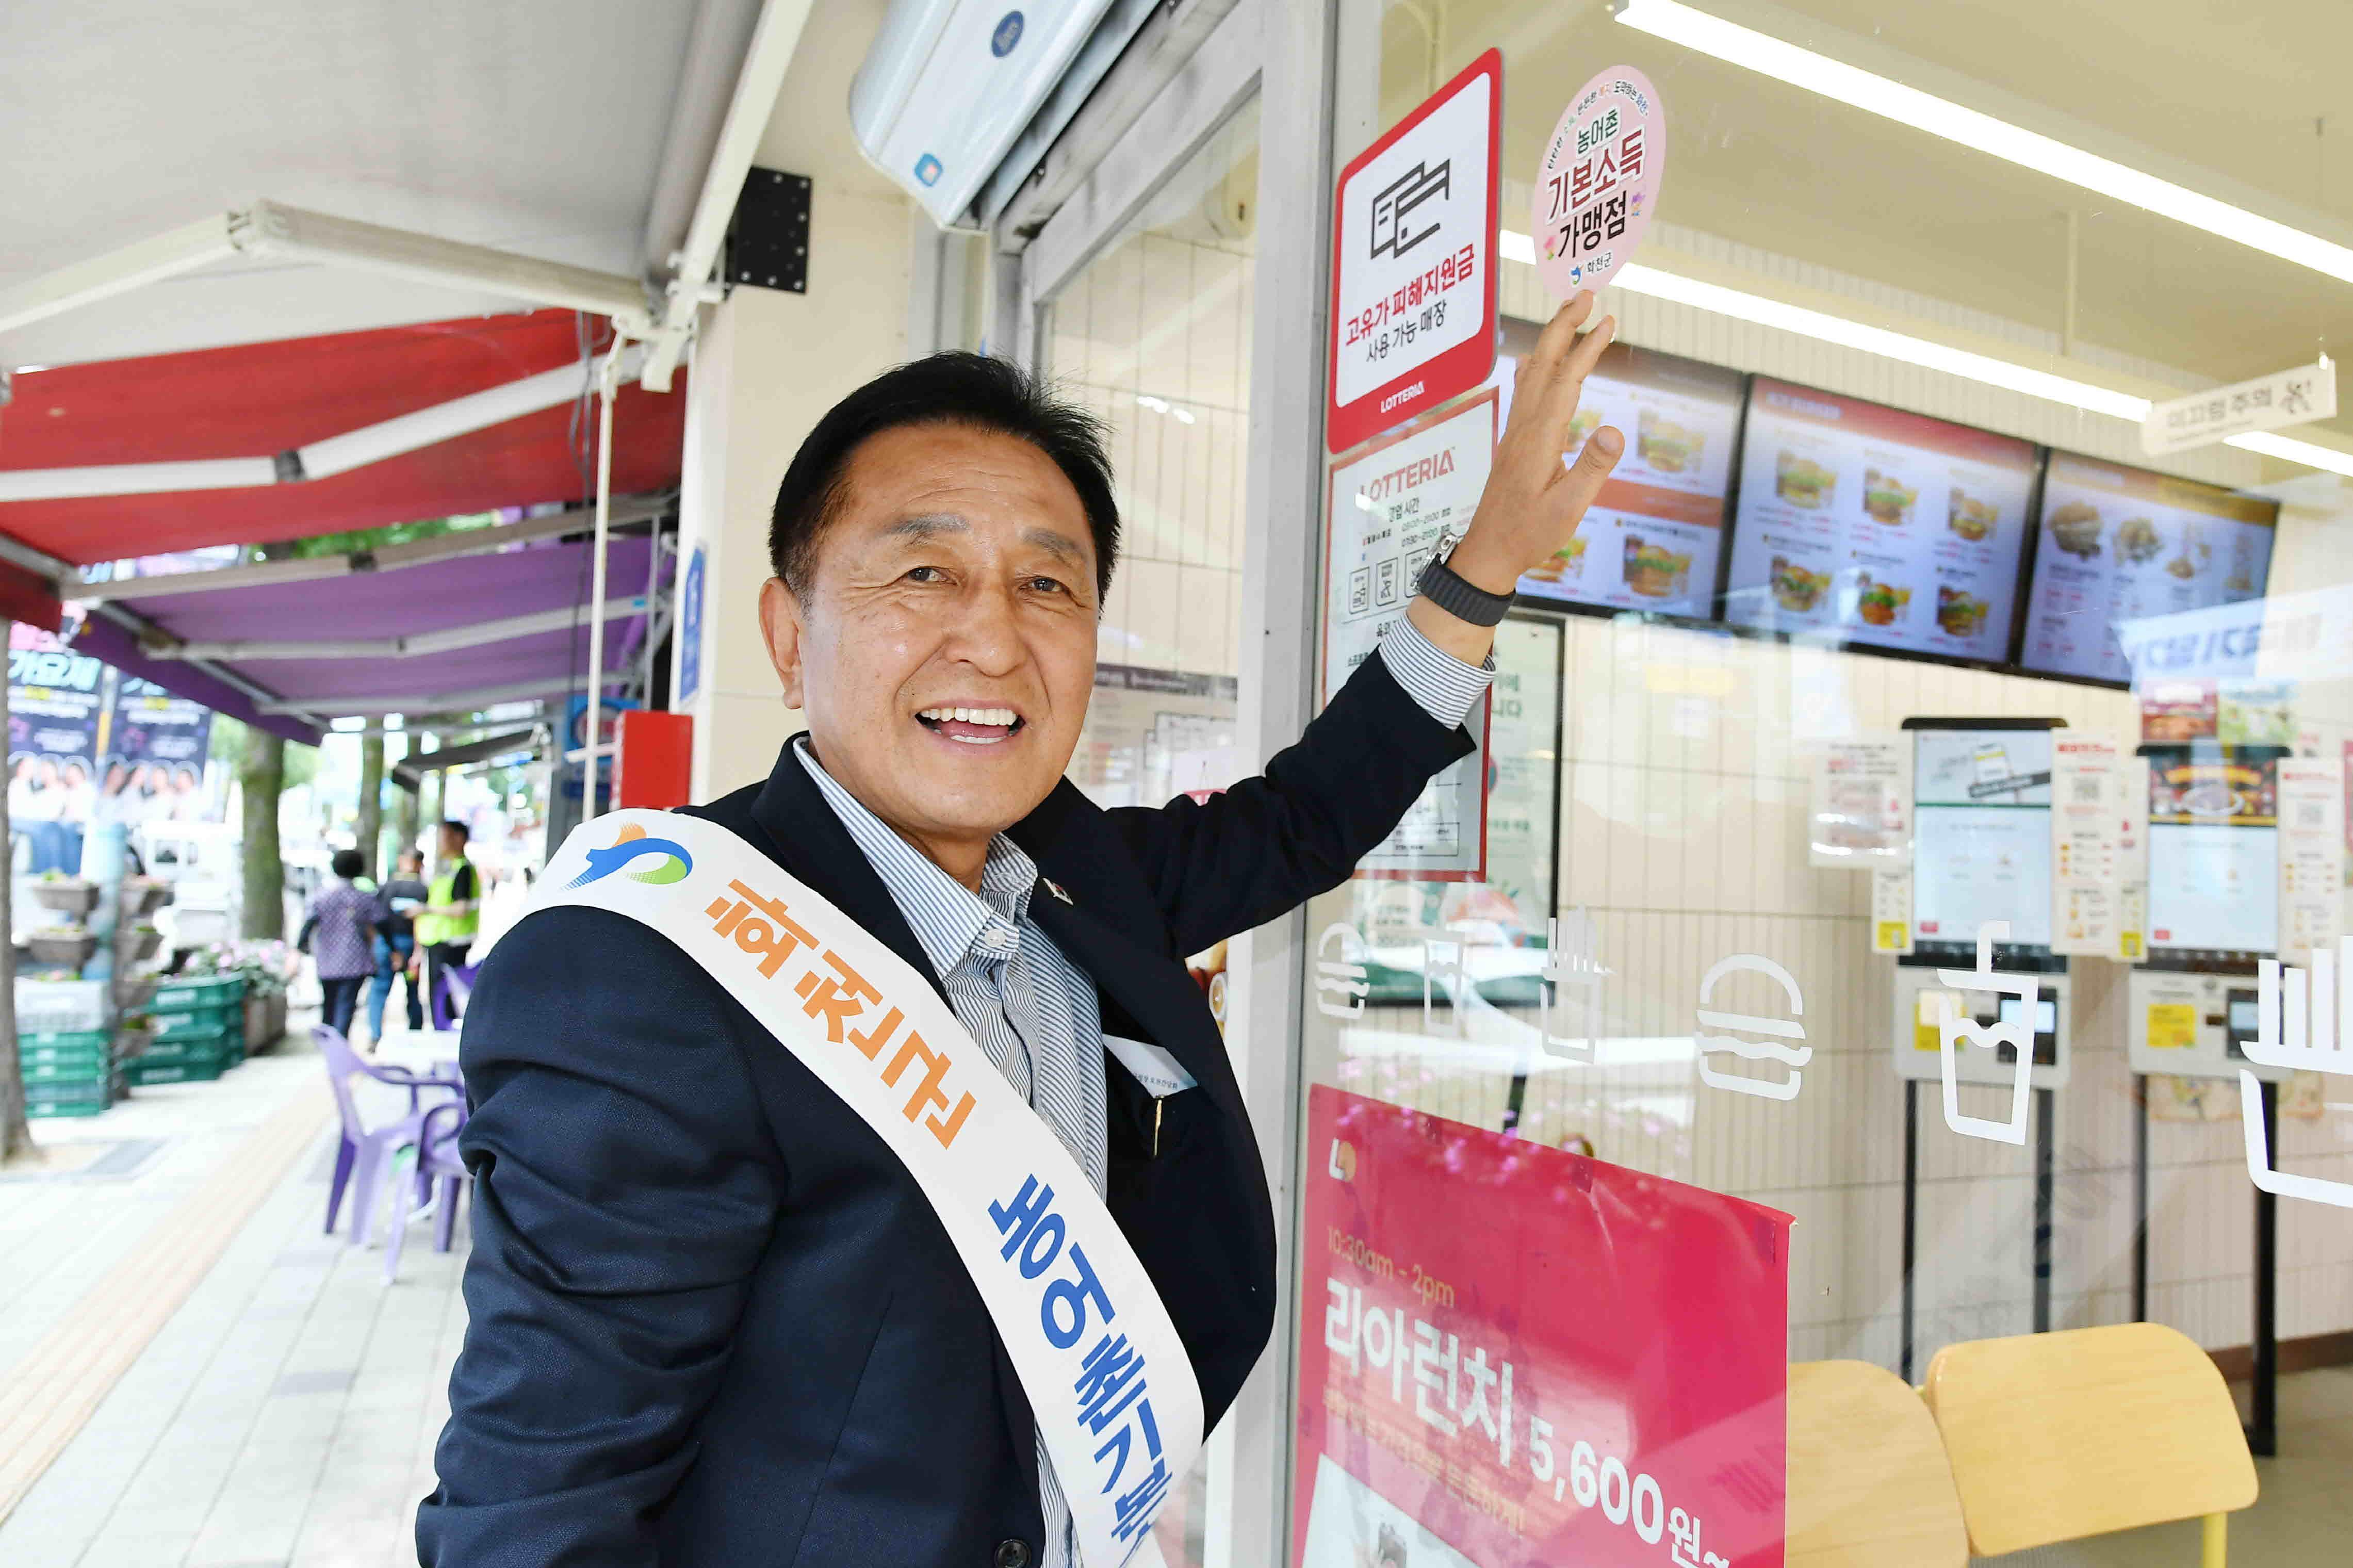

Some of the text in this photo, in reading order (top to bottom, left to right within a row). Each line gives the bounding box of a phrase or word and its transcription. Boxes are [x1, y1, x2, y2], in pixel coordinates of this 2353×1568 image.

[1577, 108, 1619, 155] 농어촌
[1548, 129, 1643, 220] 기본소득
[1558, 189, 1627, 258] 가맹점
[1587, 252, 1612, 273] 화천군
[1346, 243, 1475, 346] 고유가 피해지원금
[1366, 299, 1447, 362] 사용 가능 매장
[1380, 381, 1425, 413] LOTTERIA
[705, 879, 977, 1149] 화천군
[1328, 1225, 1394, 1280] 10:30am
[1412, 1263, 1455, 1309] 2pm
[987, 1173, 1173, 1568] 농어촌기본
[1325, 1277, 1513, 1468] 리아런치
